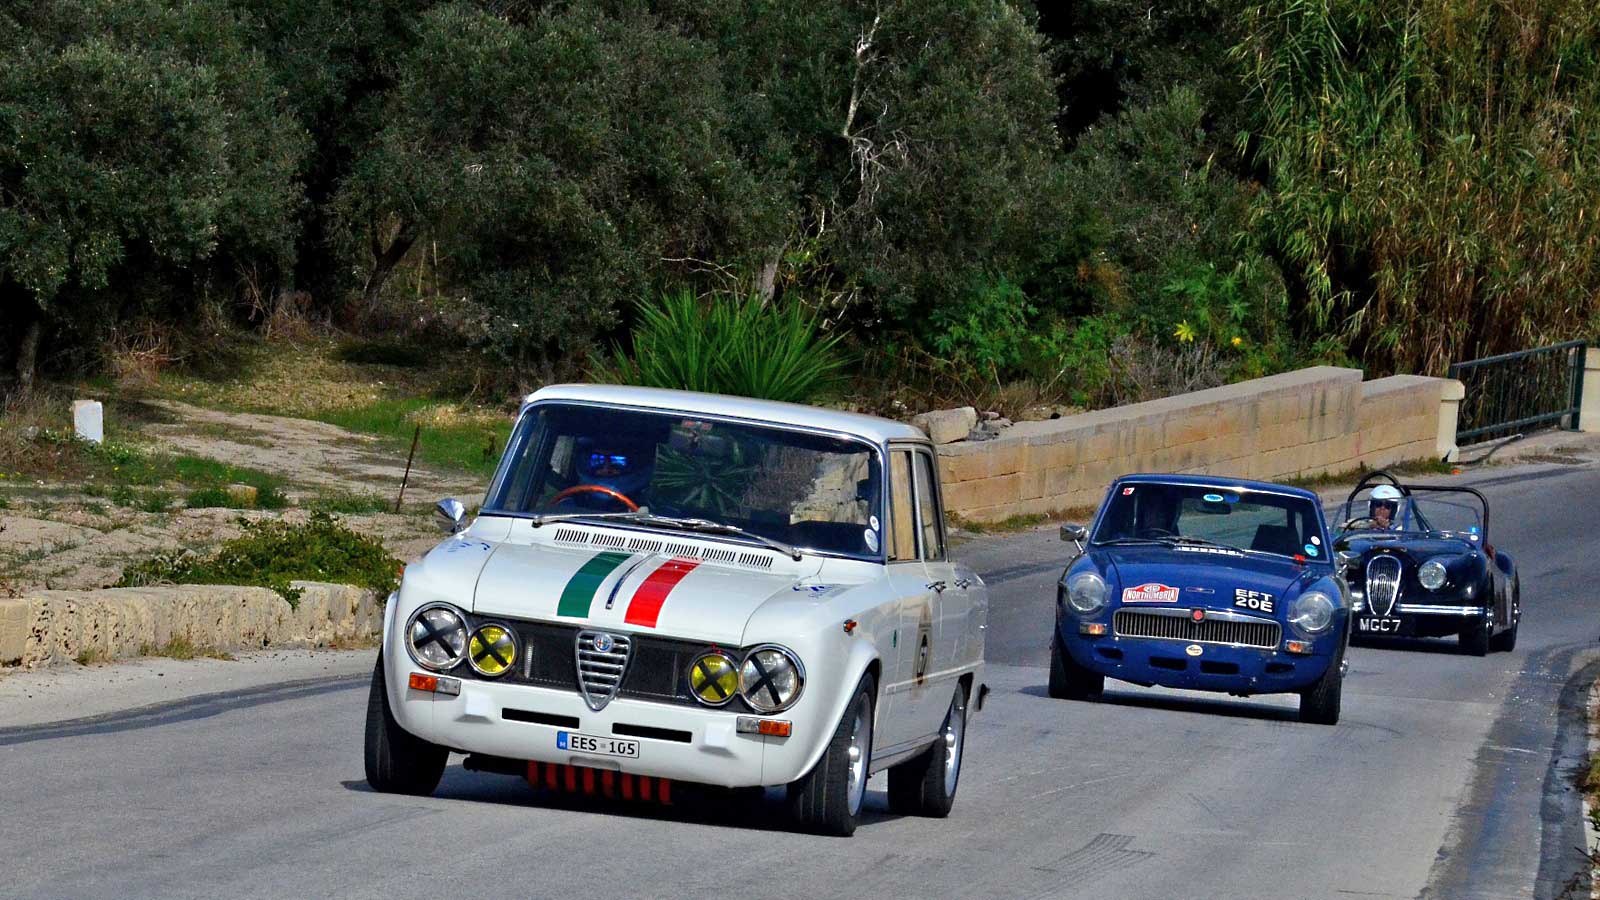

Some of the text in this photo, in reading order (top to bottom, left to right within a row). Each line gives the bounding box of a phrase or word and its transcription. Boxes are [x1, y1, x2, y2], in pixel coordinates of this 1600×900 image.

[1126, 589, 1175, 600] NORTHUMBRIA
[1235, 589, 1272, 601] EFT
[1235, 597, 1272, 612] 20E
[1360, 618, 1401, 632] MGC7
[571, 736, 635, 754] EES 105
